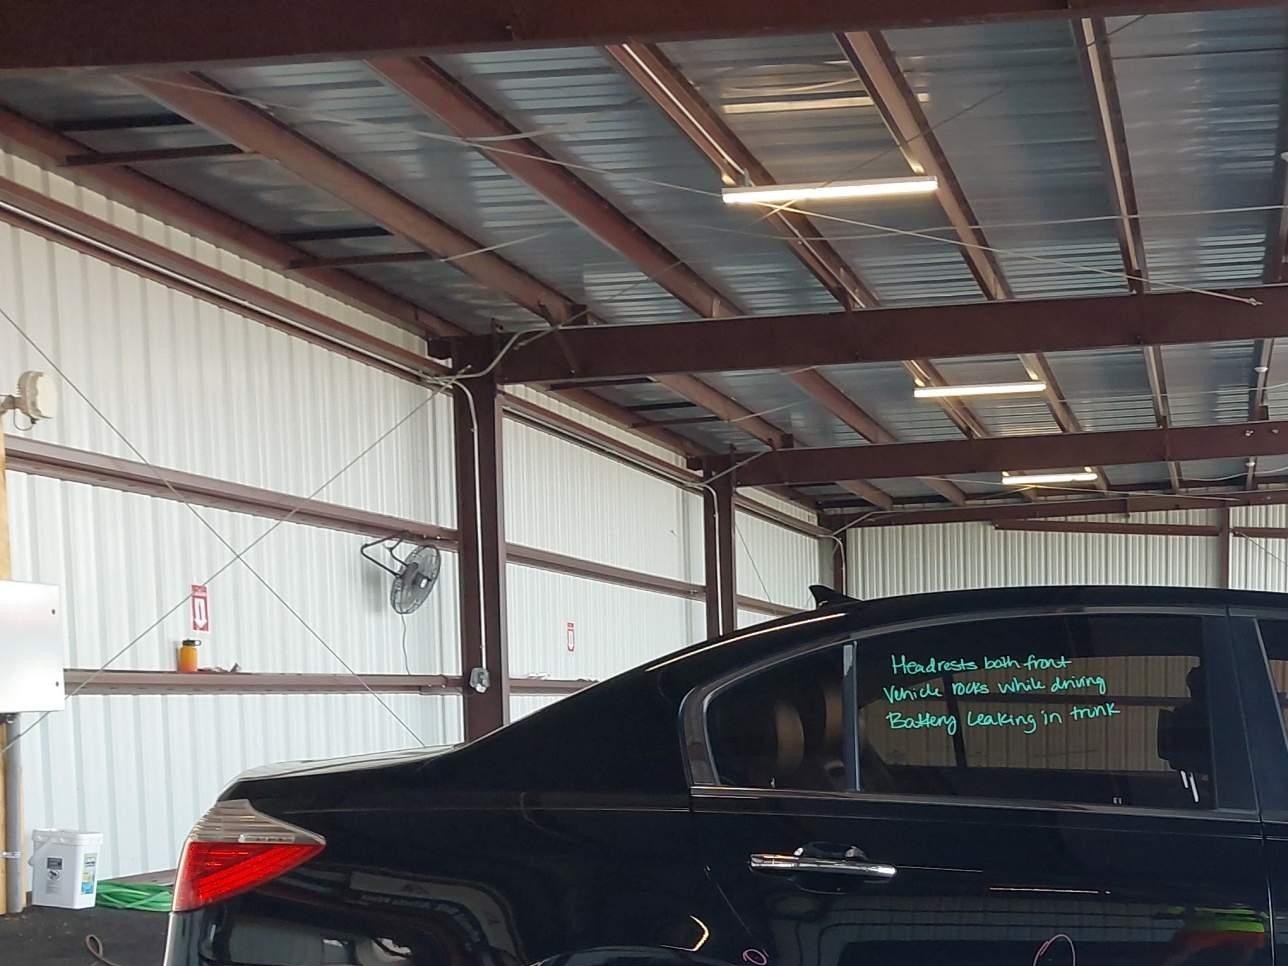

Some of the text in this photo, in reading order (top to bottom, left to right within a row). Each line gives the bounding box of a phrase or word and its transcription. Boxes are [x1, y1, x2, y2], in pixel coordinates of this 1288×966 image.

[891, 654, 1073, 675] Headrests both front
[883, 674, 1108, 704] Vehicle rocks while driving
[886, 711, 957, 735] Battery
[1043, 711, 1063, 725] in
[1070, 703, 1121, 720] trunk
